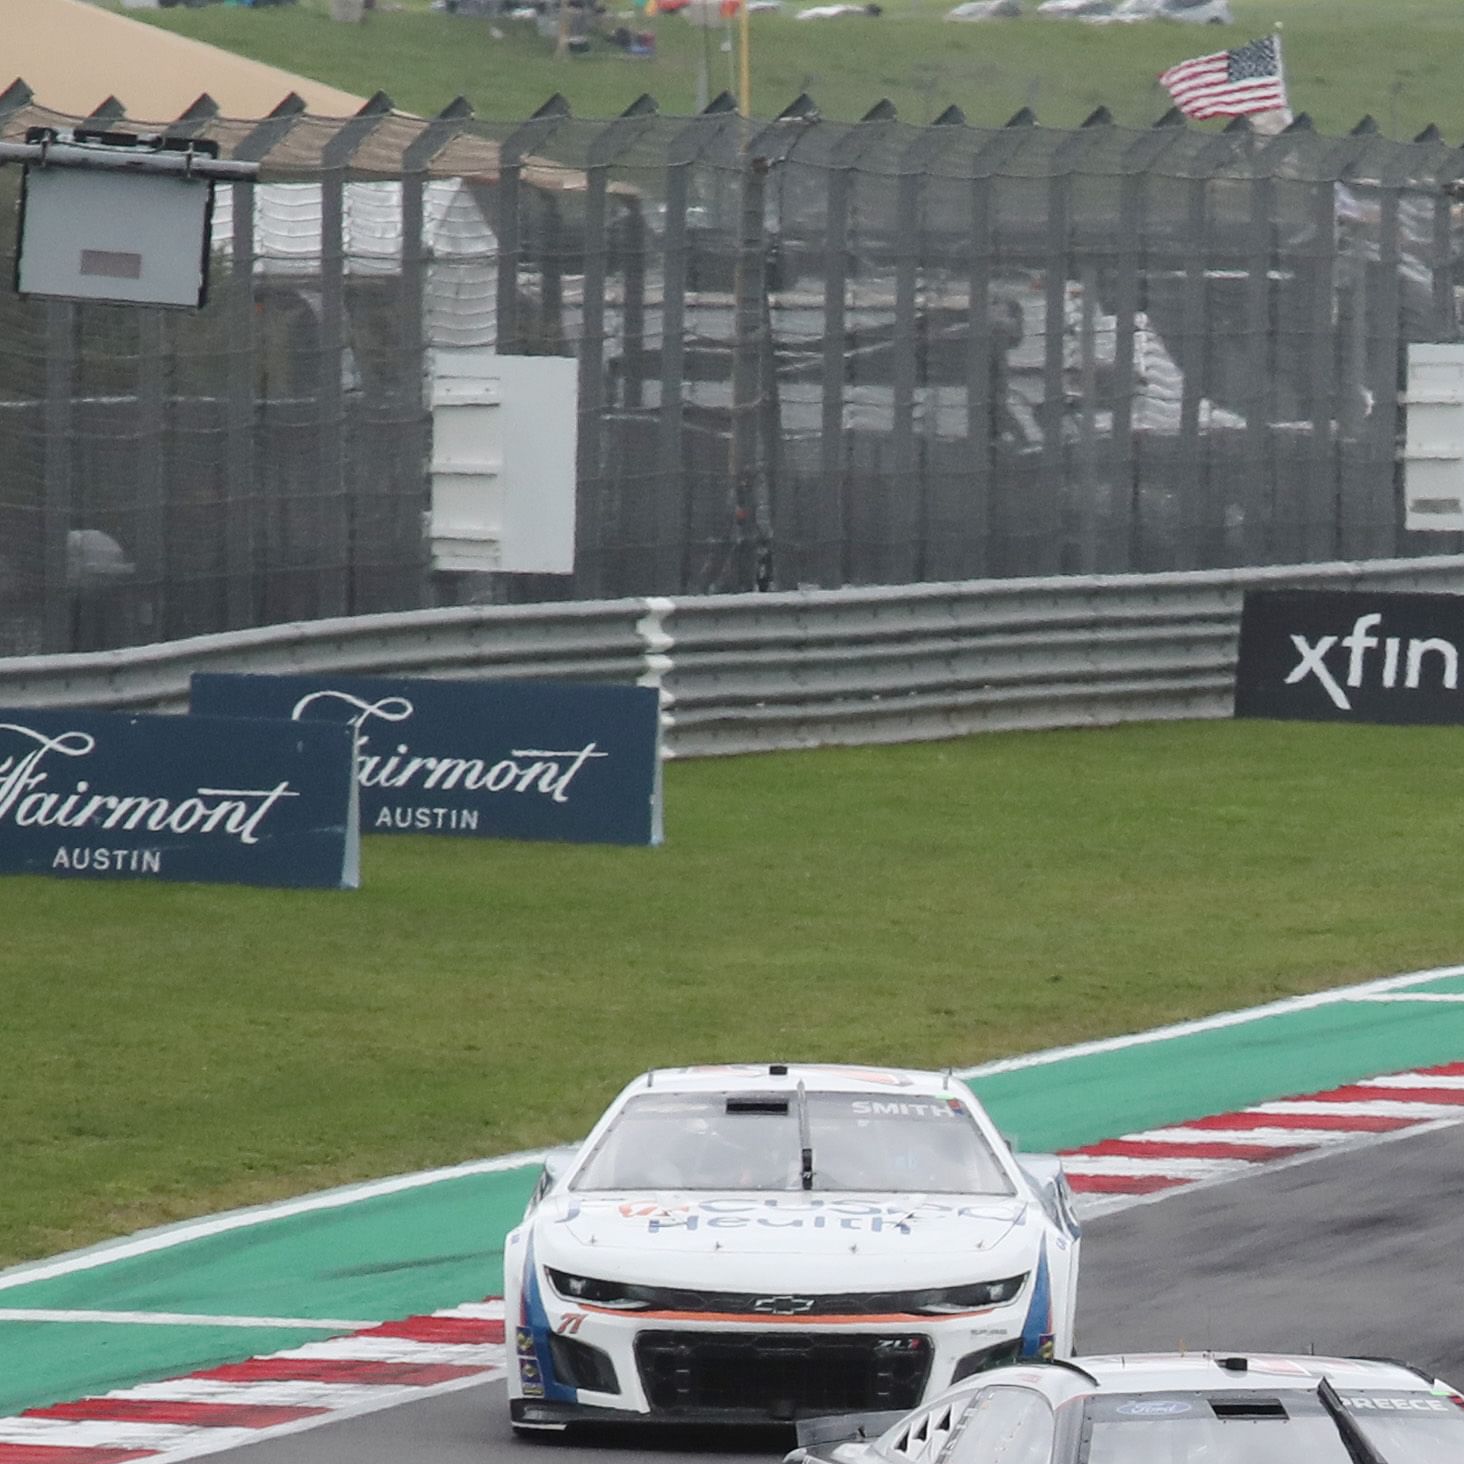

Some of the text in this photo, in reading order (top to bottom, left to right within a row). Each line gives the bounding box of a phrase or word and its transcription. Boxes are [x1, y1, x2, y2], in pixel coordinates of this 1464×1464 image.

[376, 806, 479, 830] AUSTIN
[53, 847, 161, 872] AUSTIN
[852, 1100, 955, 1118] SMITH
[556, 1313, 588, 1335] 71
